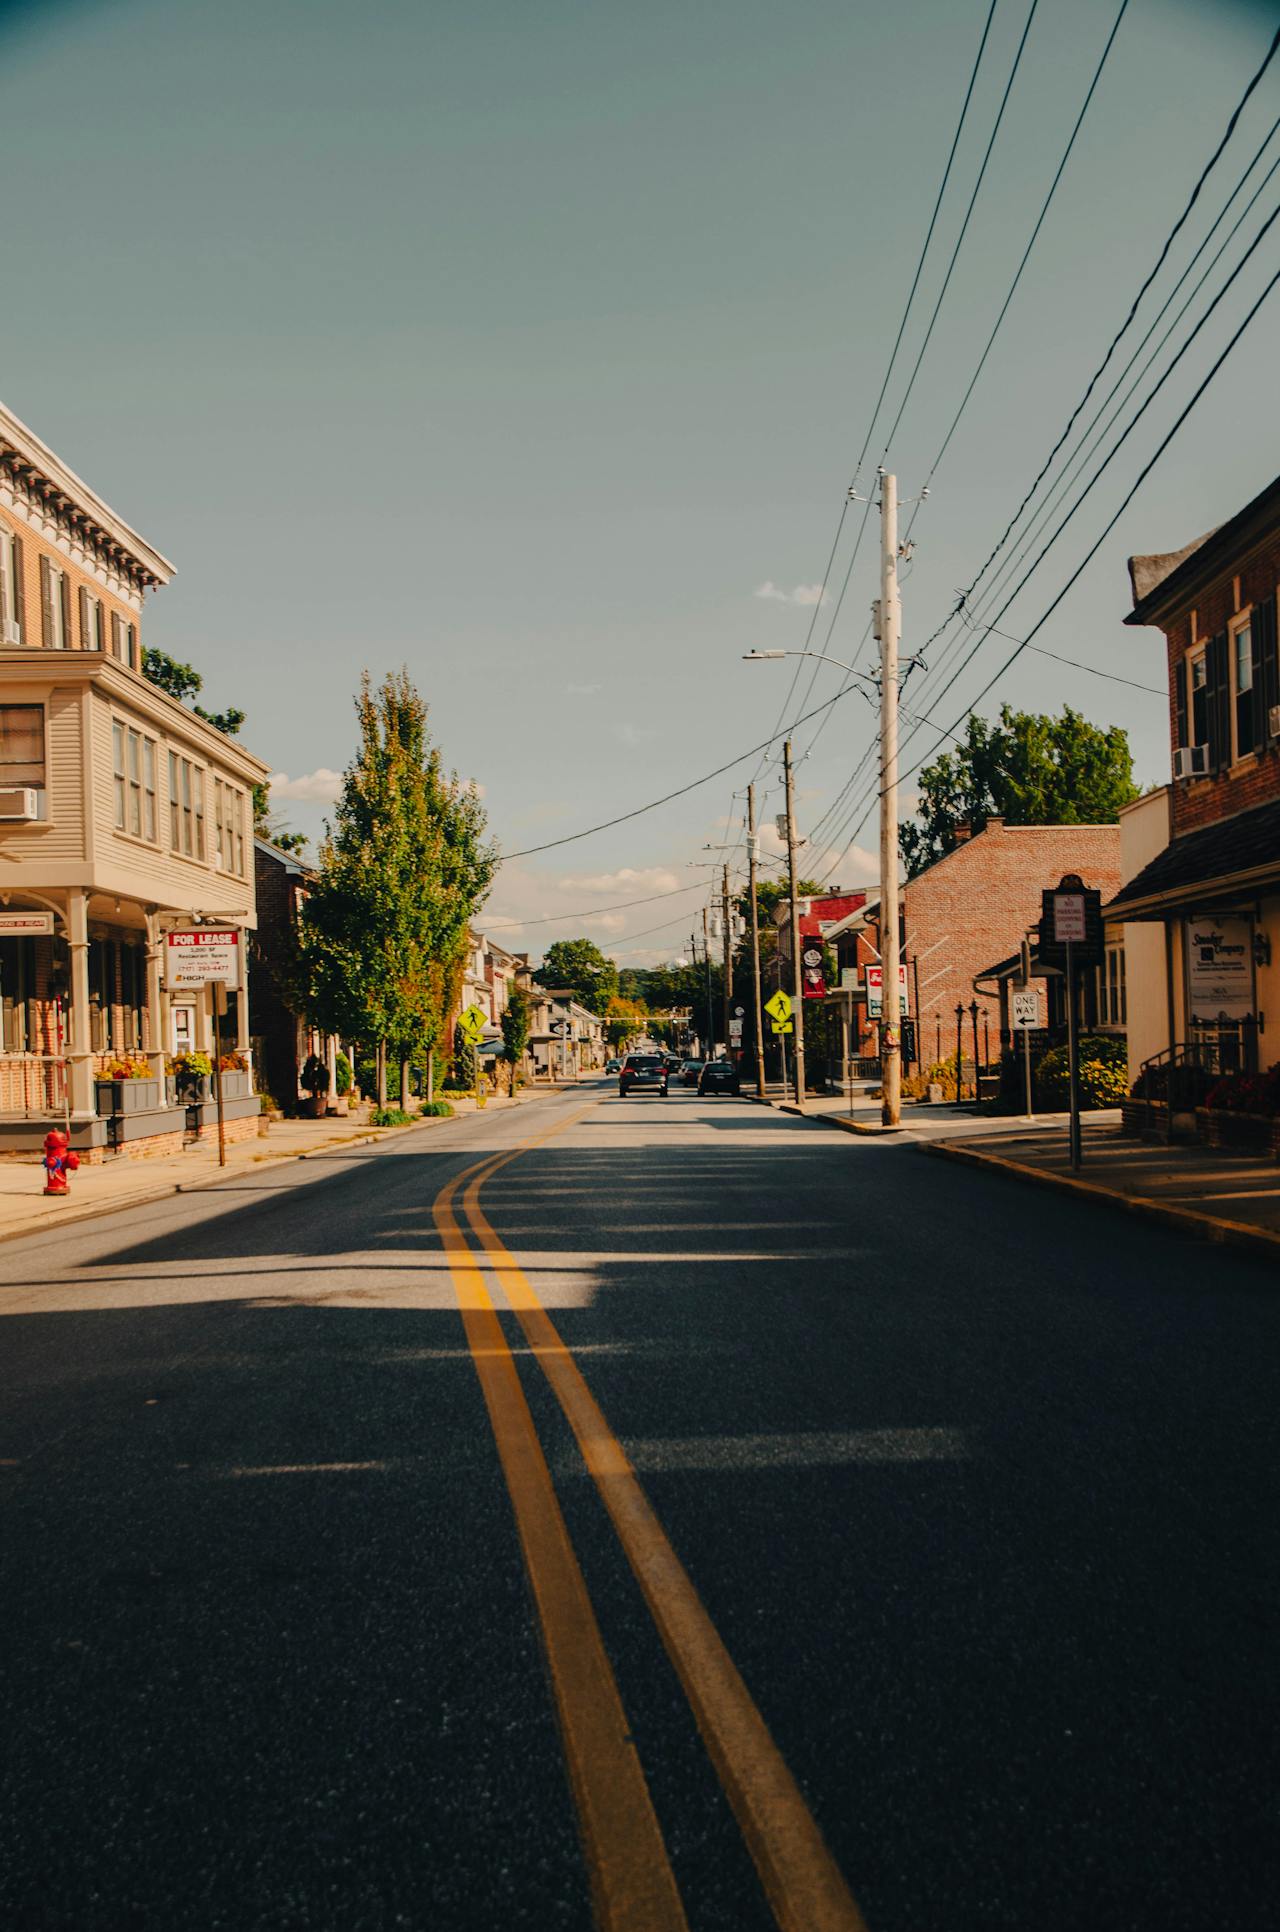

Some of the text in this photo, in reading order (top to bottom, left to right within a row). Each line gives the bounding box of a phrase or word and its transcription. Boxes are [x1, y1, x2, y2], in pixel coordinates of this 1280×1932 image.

[173, 934, 233, 945] FOR LEASE
[1016, 996, 1035, 1005] ONE
[1016, 1007, 1035, 1015] WAY
